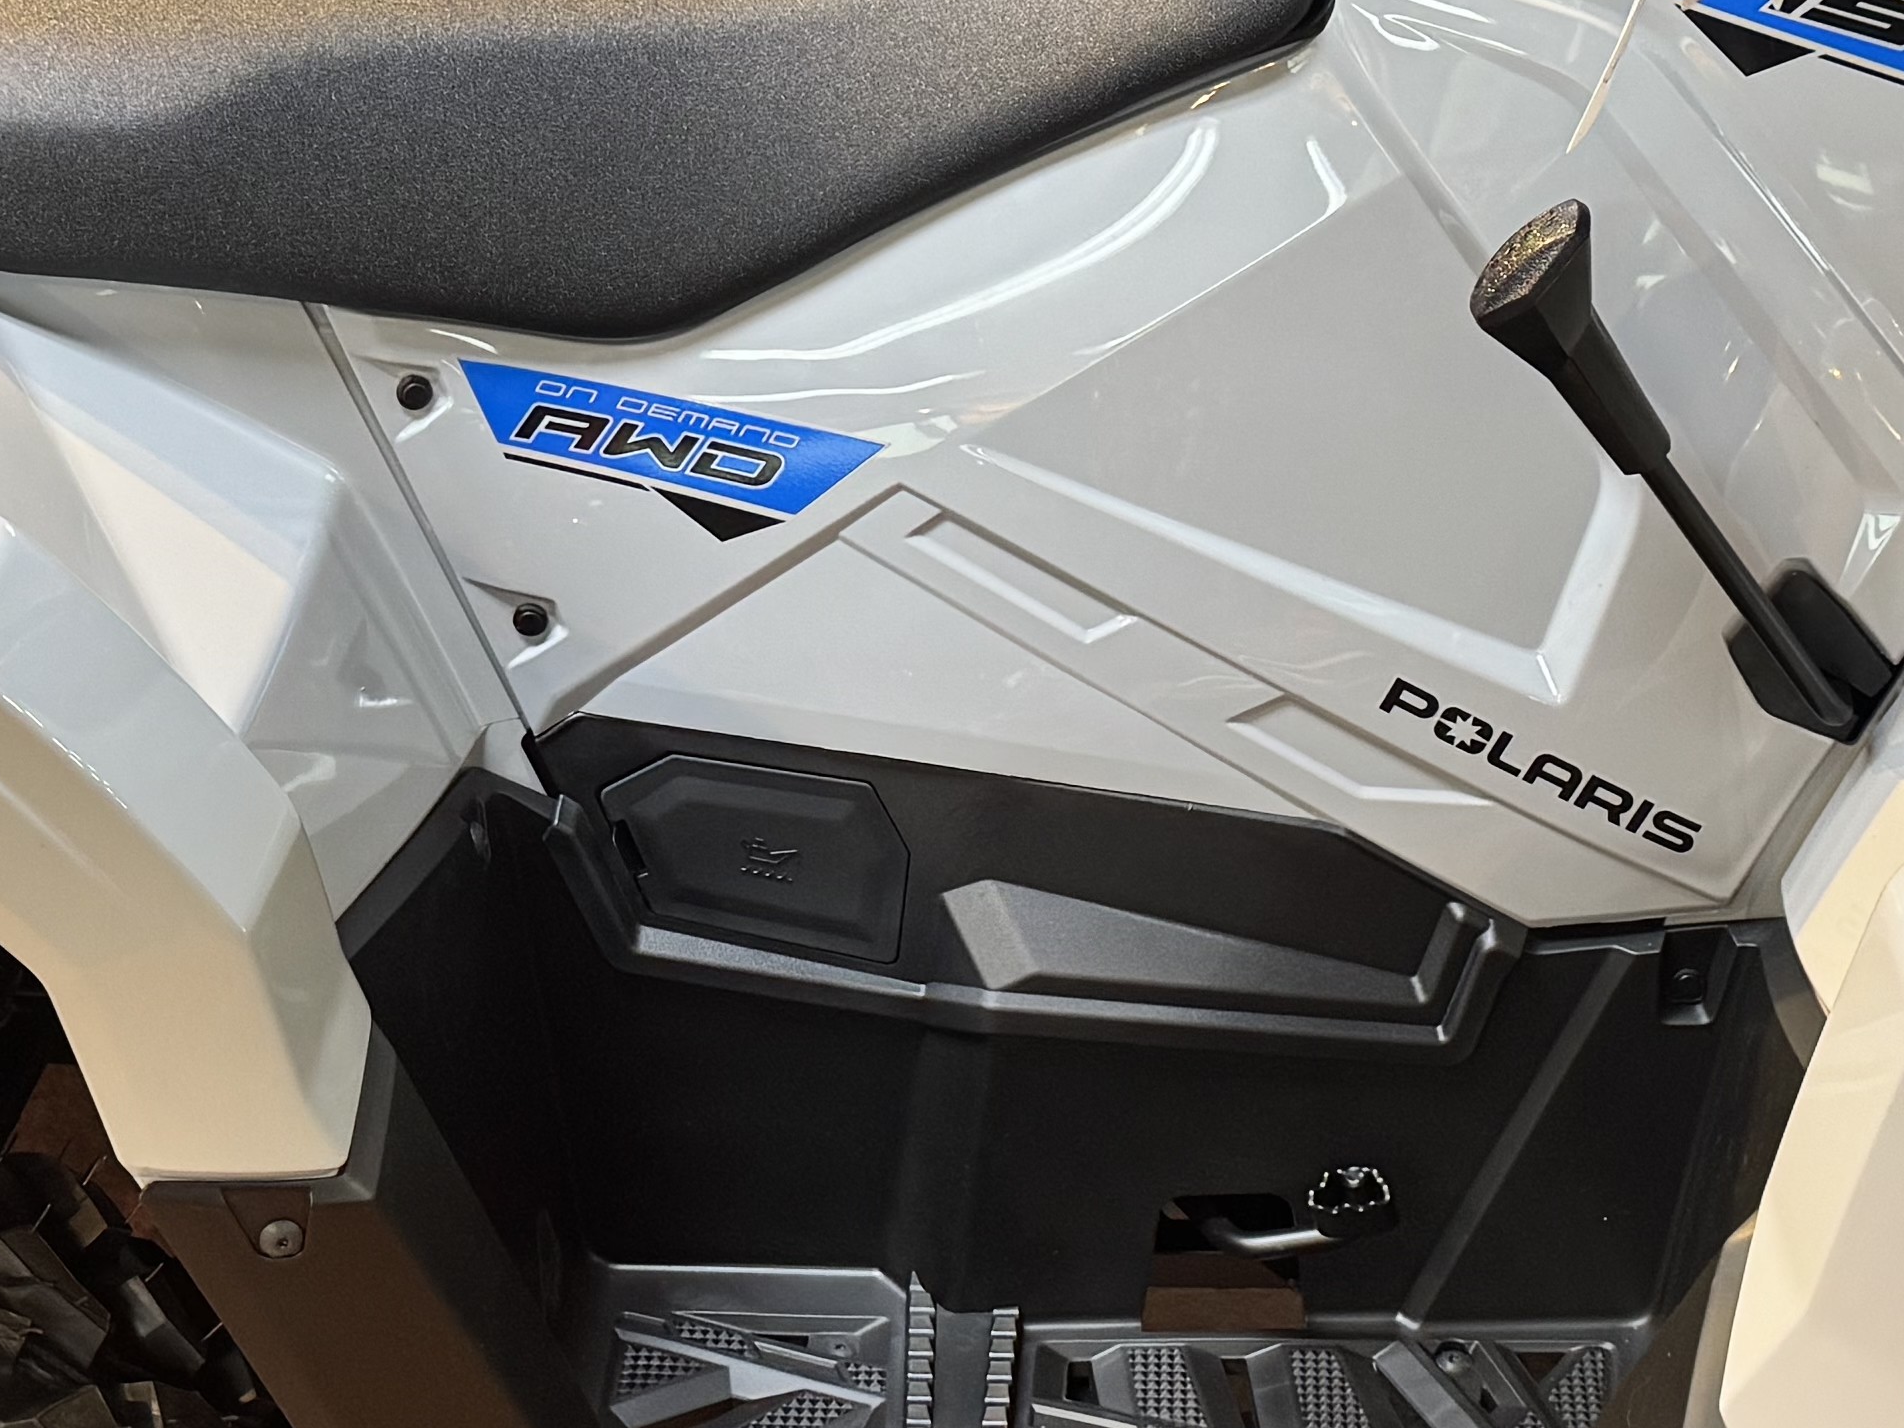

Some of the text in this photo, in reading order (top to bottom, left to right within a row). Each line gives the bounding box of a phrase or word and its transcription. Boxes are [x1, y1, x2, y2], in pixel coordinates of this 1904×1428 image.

[510, 405, 786, 489] AWD
[534, 380, 801, 448] ON DEMAND
[1378, 677, 1703, 854] POLARIS
